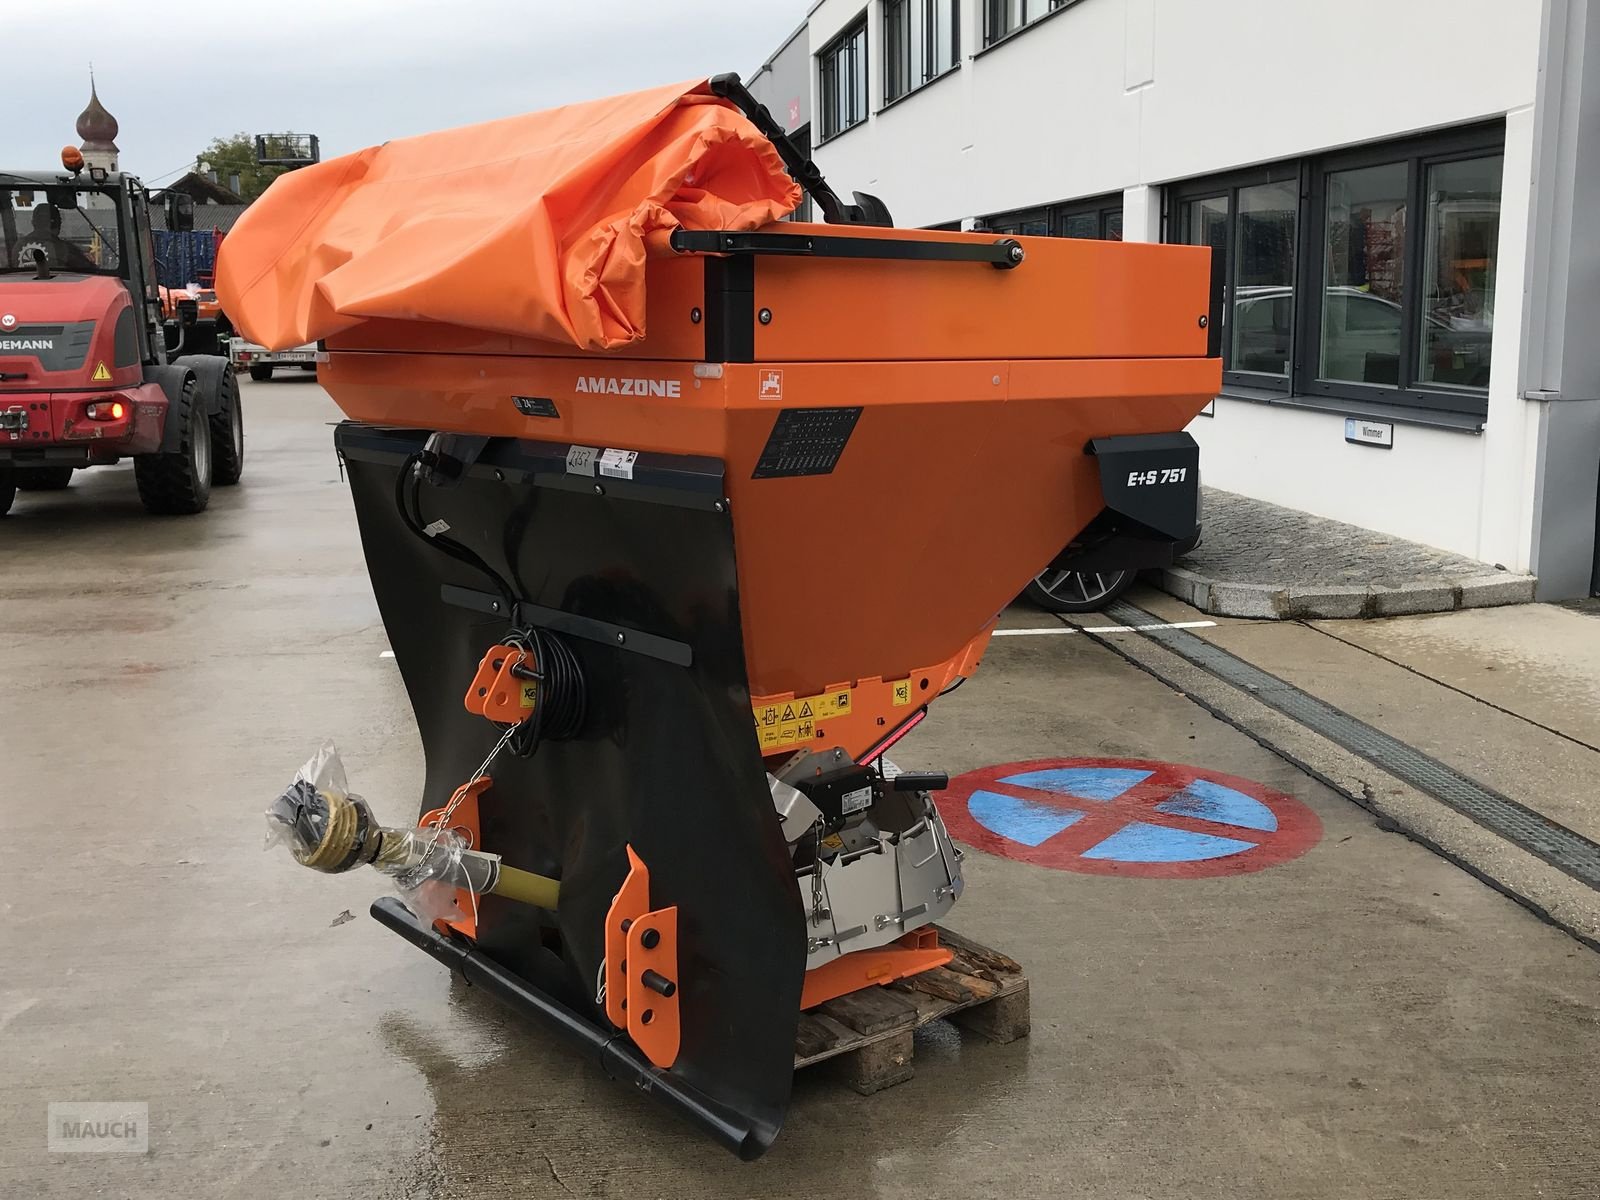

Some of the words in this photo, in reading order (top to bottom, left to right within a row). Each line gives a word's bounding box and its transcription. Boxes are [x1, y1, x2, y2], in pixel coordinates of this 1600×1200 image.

[0, 340, 53, 350] EMANN
[575, 376, 681, 398] AMAZONE
[1362, 426, 1384, 438] Wimmer
[1127, 469, 1158, 487] E+S
[1160, 467, 1187, 485] 751
